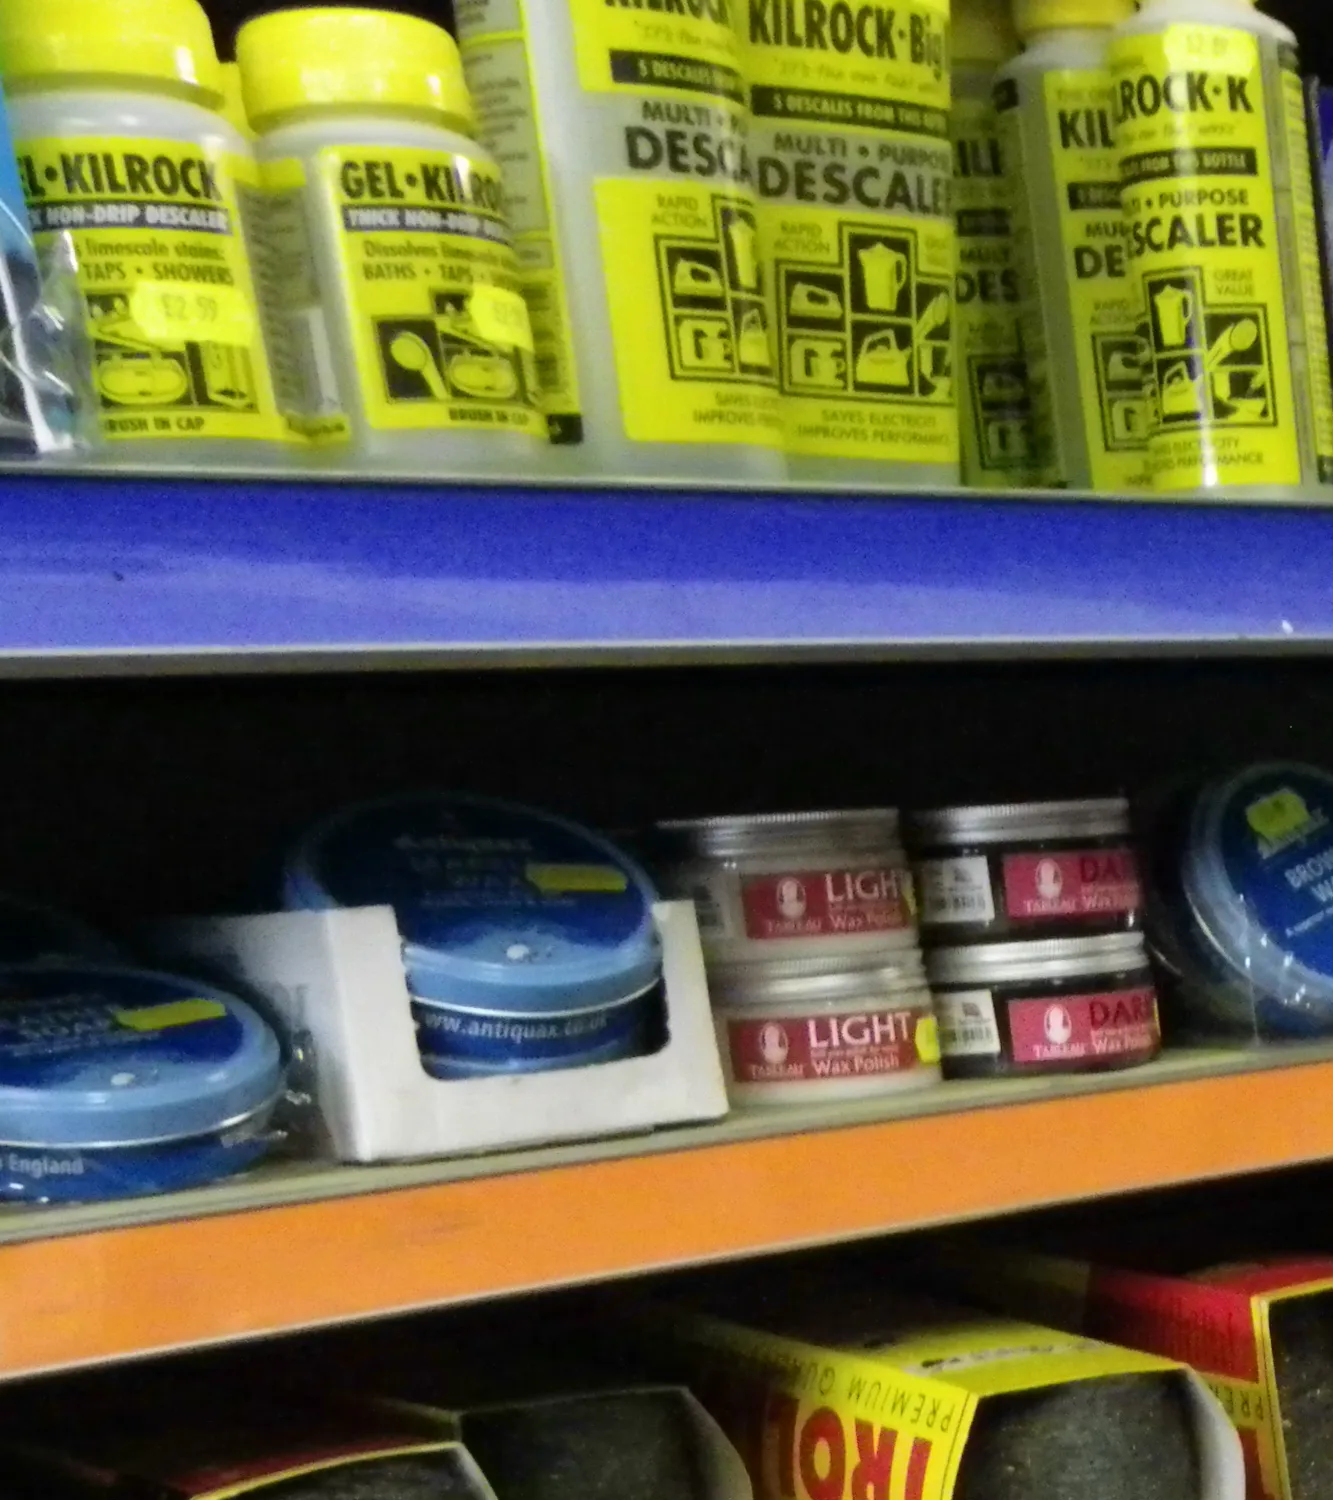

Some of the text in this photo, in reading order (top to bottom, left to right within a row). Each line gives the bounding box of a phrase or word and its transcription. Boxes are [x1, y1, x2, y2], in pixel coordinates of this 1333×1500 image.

[747, 0, 898, 60] KILROCK
[1157, 188, 1249, 208] PURPOSE
[807, 1011, 912, 1048] LIGHT
[811, 1054, 900, 1076] Wax Polish
[848, 1376, 954, 1436] PREMIUM
